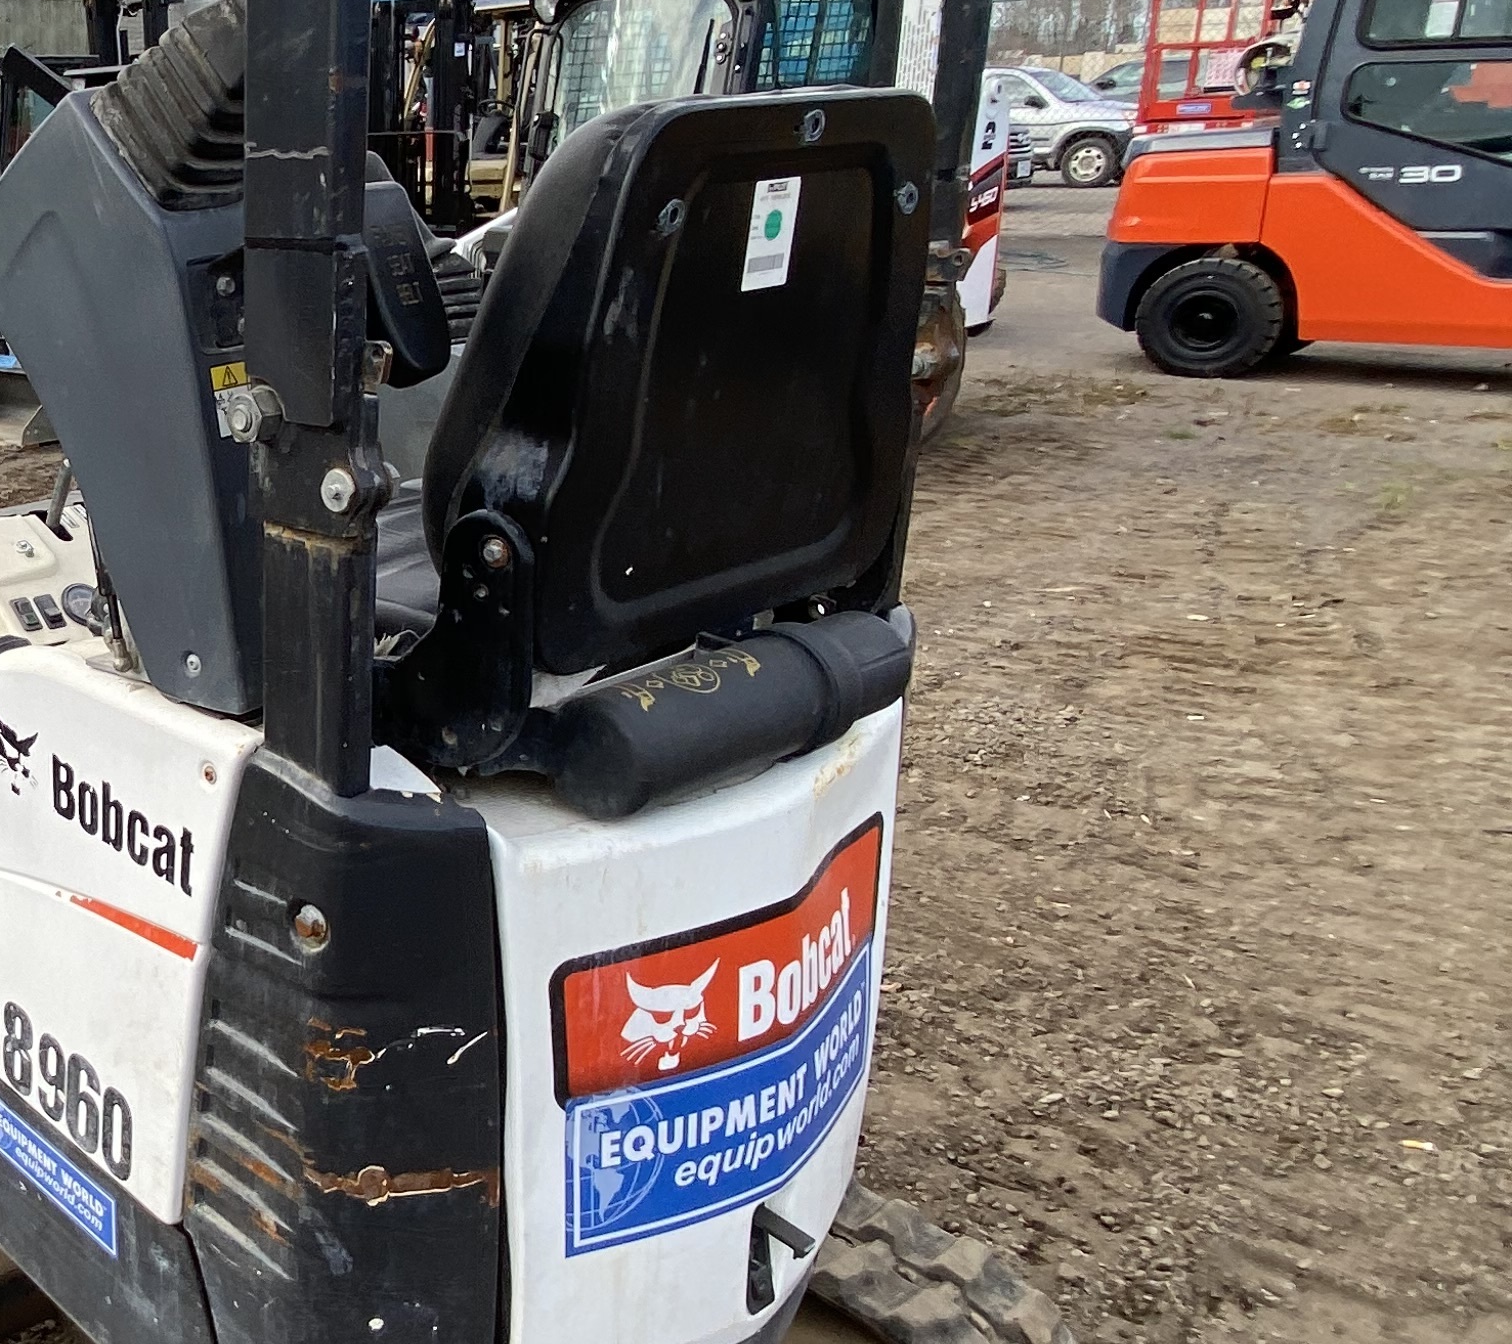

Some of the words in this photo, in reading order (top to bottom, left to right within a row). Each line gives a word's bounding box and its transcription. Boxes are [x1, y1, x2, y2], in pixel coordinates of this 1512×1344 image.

[1398, 164, 1462, 184] 30
[51, 752, 195, 898] Bobcat
[736, 887, 852, 1043] Bobcat
[2, 1000, 133, 1182] 8960
[599, 1061, 808, 1169] EQUIPMENT
[813, 989, 863, 1081] WORLD
[673, 1033, 860, 1187] equipworld.com
[14, 1145, 104, 1233] equipworld.com
[60, 1167, 105, 1218] WORLD
